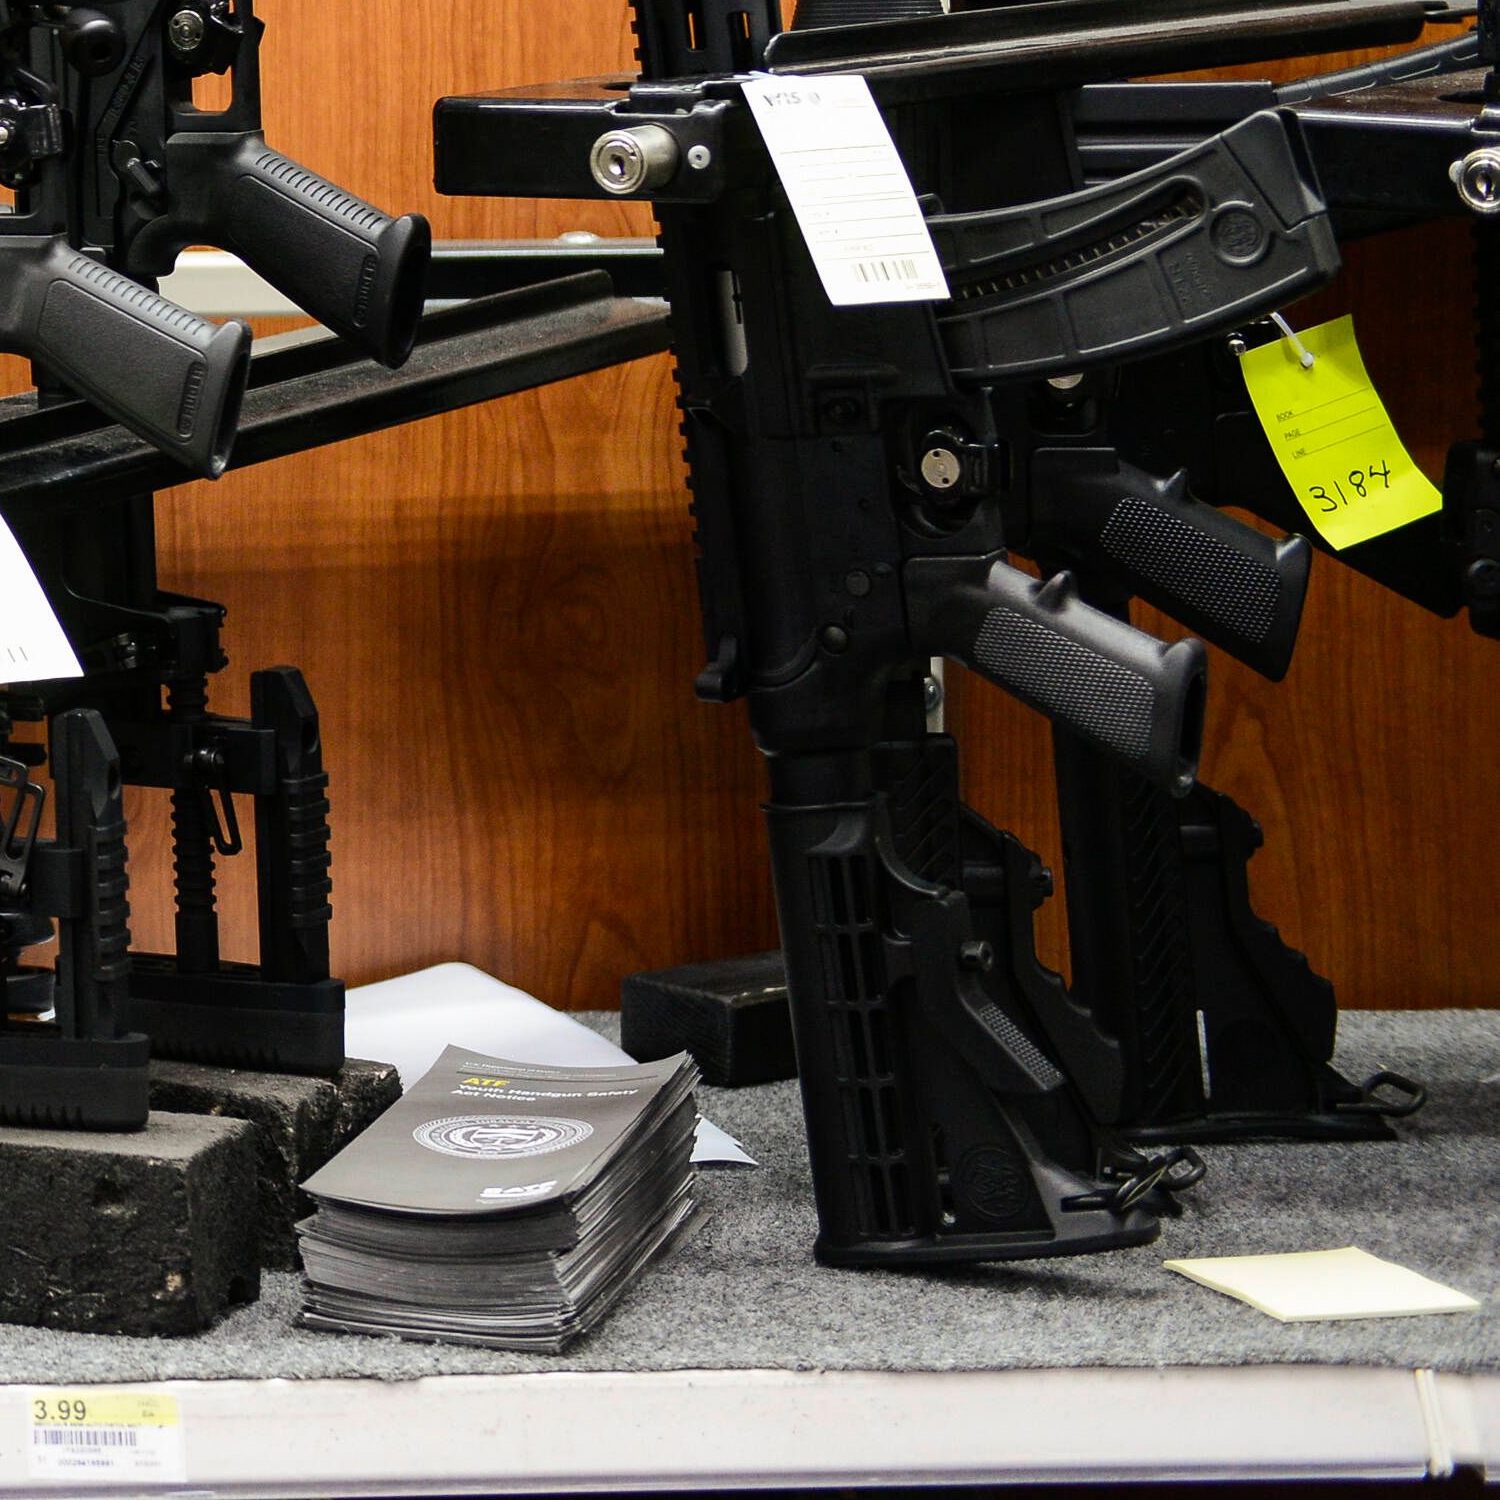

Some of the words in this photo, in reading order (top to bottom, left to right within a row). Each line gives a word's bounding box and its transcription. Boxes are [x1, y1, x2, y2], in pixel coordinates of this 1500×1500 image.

[1276, 410, 1293, 420] BOOK
[1284, 428, 1300, 439] PAGE
[1292, 448, 1306, 459] LINE
[1310, 460, 1390, 512] 3184
[462, 1077, 511, 1087] ATF
[458, 1084, 504, 1094] Youth
[507, 1088, 582, 1098] Handgun
[586, 1088, 639, 1097] Safety
[484, 1091, 537, 1101] Notice
[34, 1399, 86, 1420] 3.99
